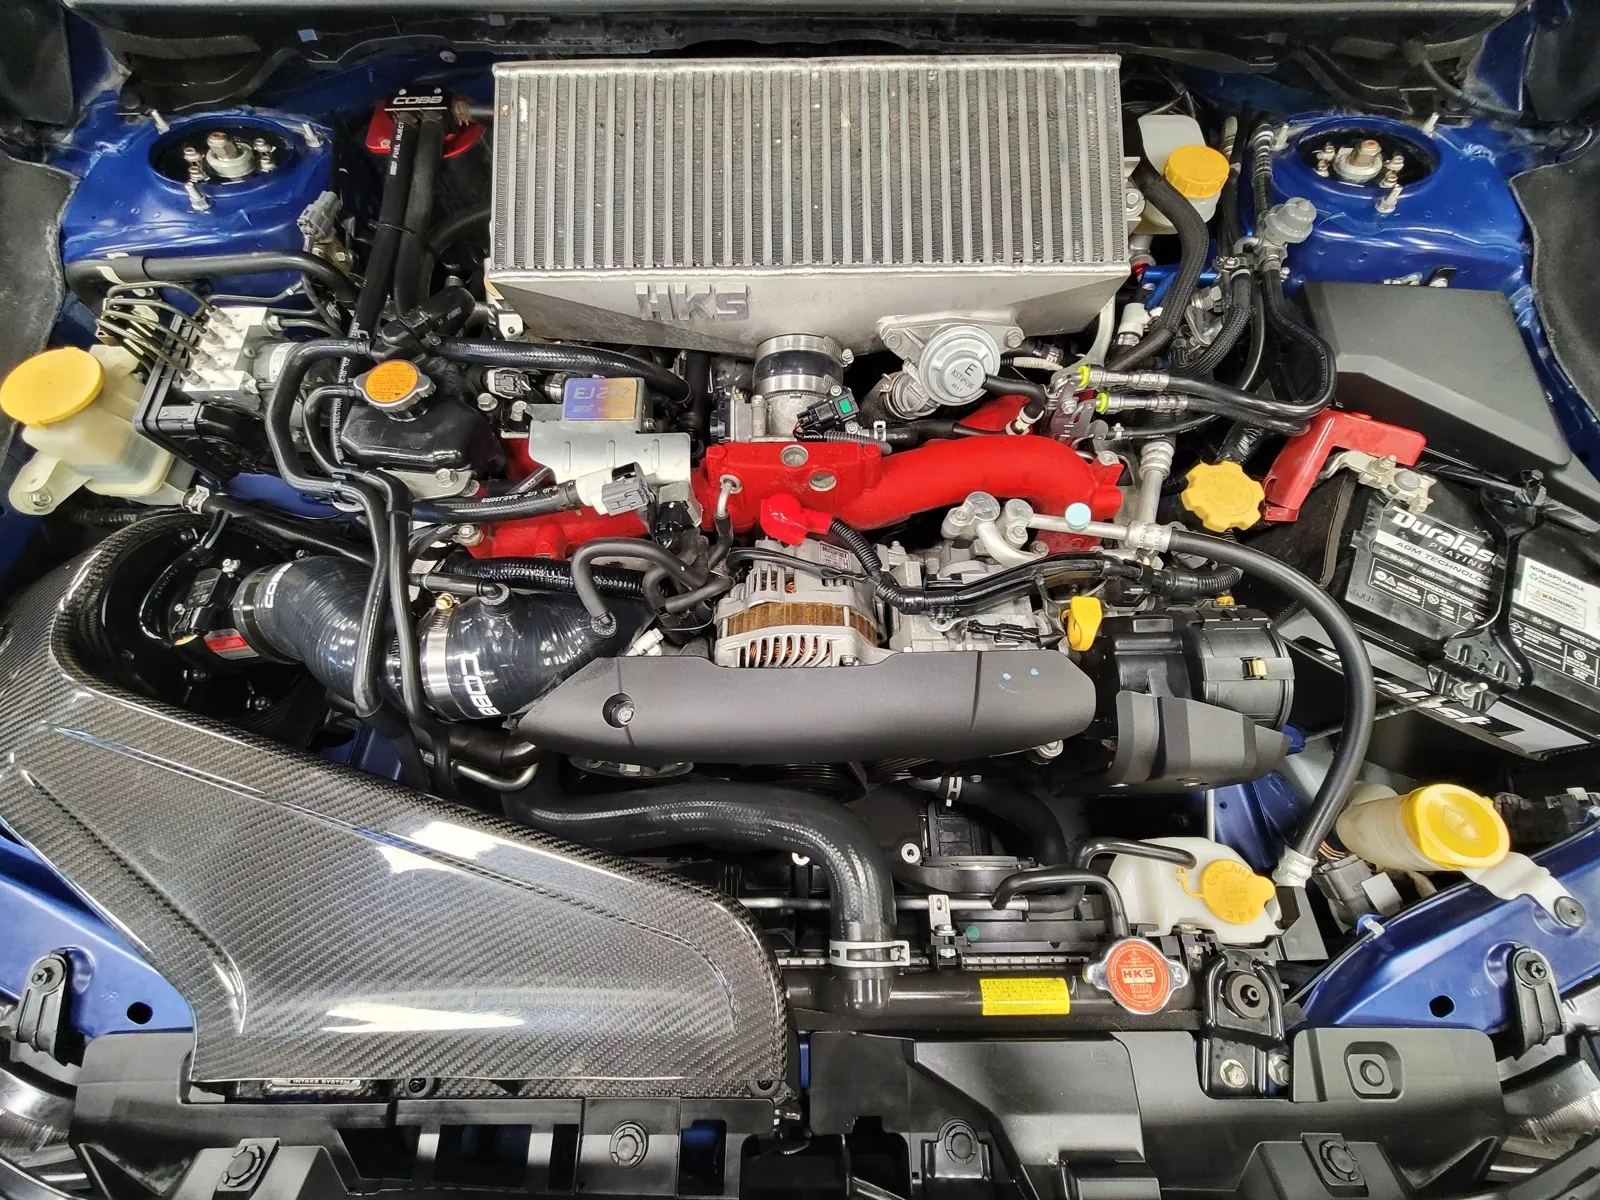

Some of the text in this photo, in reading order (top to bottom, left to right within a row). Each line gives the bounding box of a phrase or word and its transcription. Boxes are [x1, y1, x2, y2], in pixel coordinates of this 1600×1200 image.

[393, 96, 443, 105] COBB
[392, 143, 401, 159] FUEL
[635, 282, 749, 321] HKS
[964, 363, 978, 377] E
[1396, 542, 1422, 556] AGM
[1425, 553, 1491, 586] TECHNOLOG
[1530, 564, 1585, 592] NON-SPILLABLE
[461, 653, 502, 716] COBB
[1206, 863, 1254, 886] COOLANT
[1122, 969, 1154, 979] HKS
